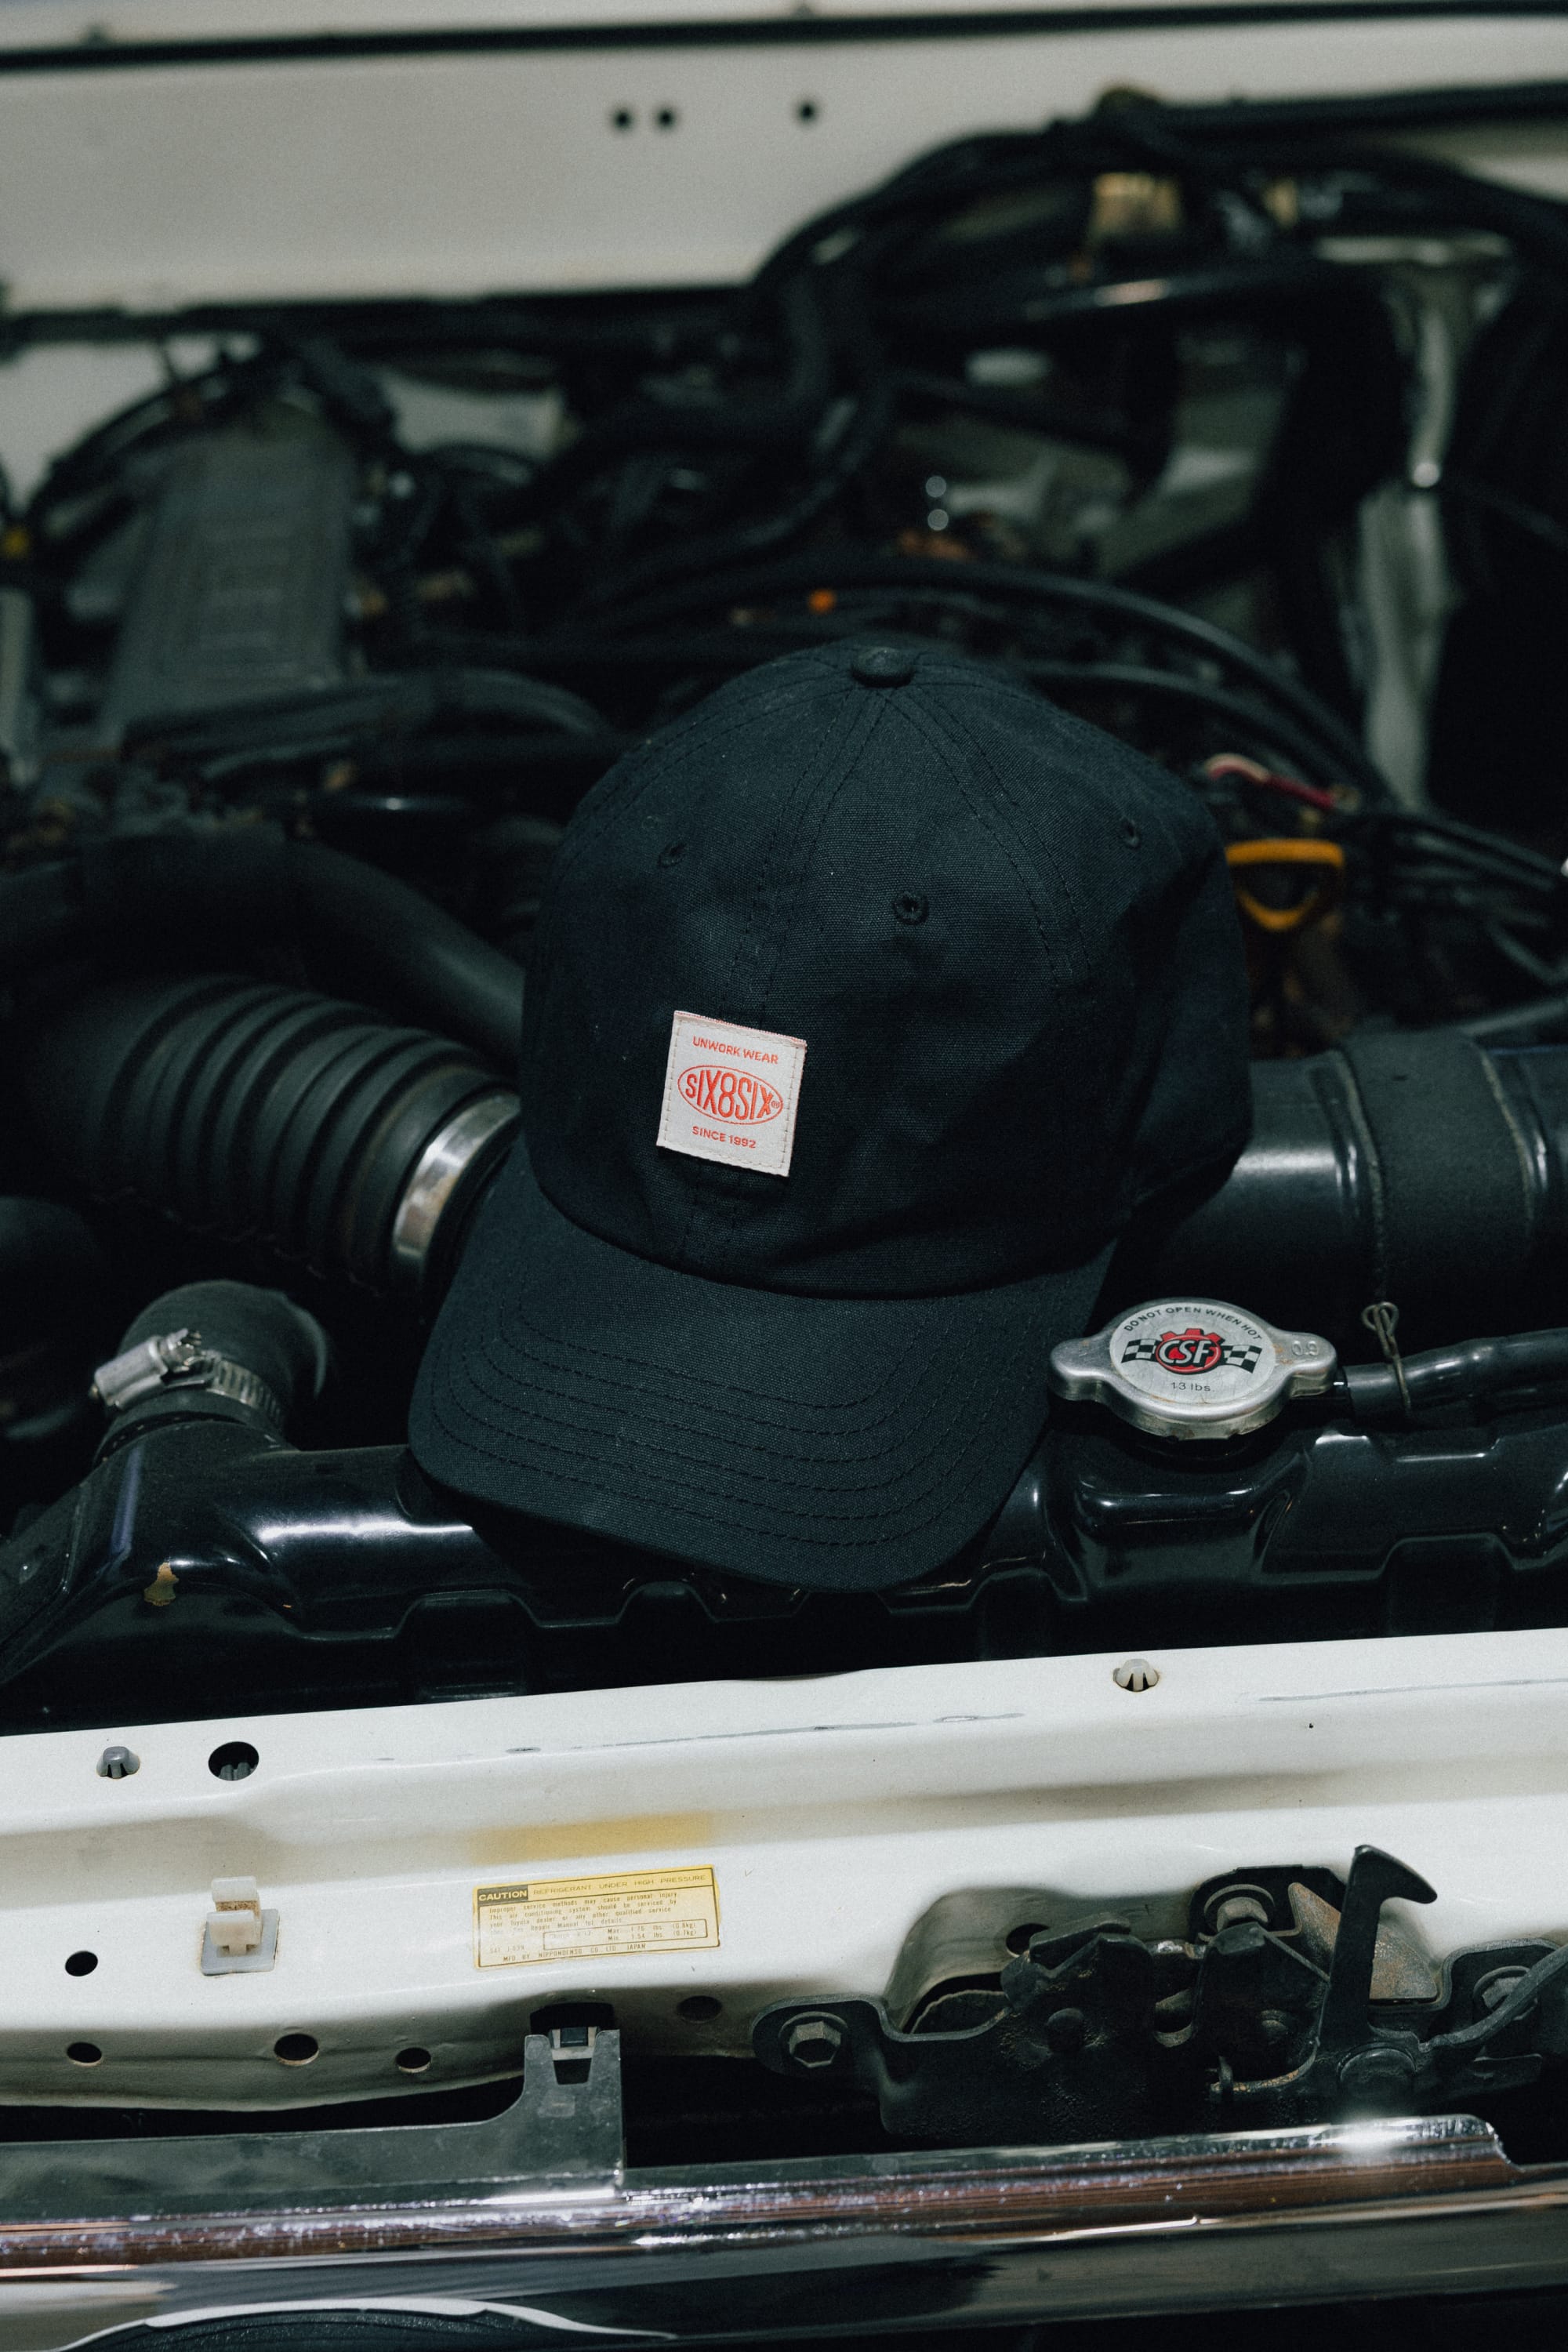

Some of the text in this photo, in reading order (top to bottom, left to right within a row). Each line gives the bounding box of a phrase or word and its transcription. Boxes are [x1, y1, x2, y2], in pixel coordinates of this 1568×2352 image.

[692, 1036, 779, 1065] UNWORK WEAR
[692, 1126, 757, 1149] SINCE 1992
[1123, 1306, 1261, 1341] DO NOT OPEN WHEN HOT
[1159, 1338, 1212, 1366] CSF
[478, 1889, 528, 1902] CAUTION
[533, 1884, 592, 1895] REFRIGERANT
[660, 1875, 706, 1884] PRESSURE
[539, 1949, 582, 1958] NIPPONDENSO
